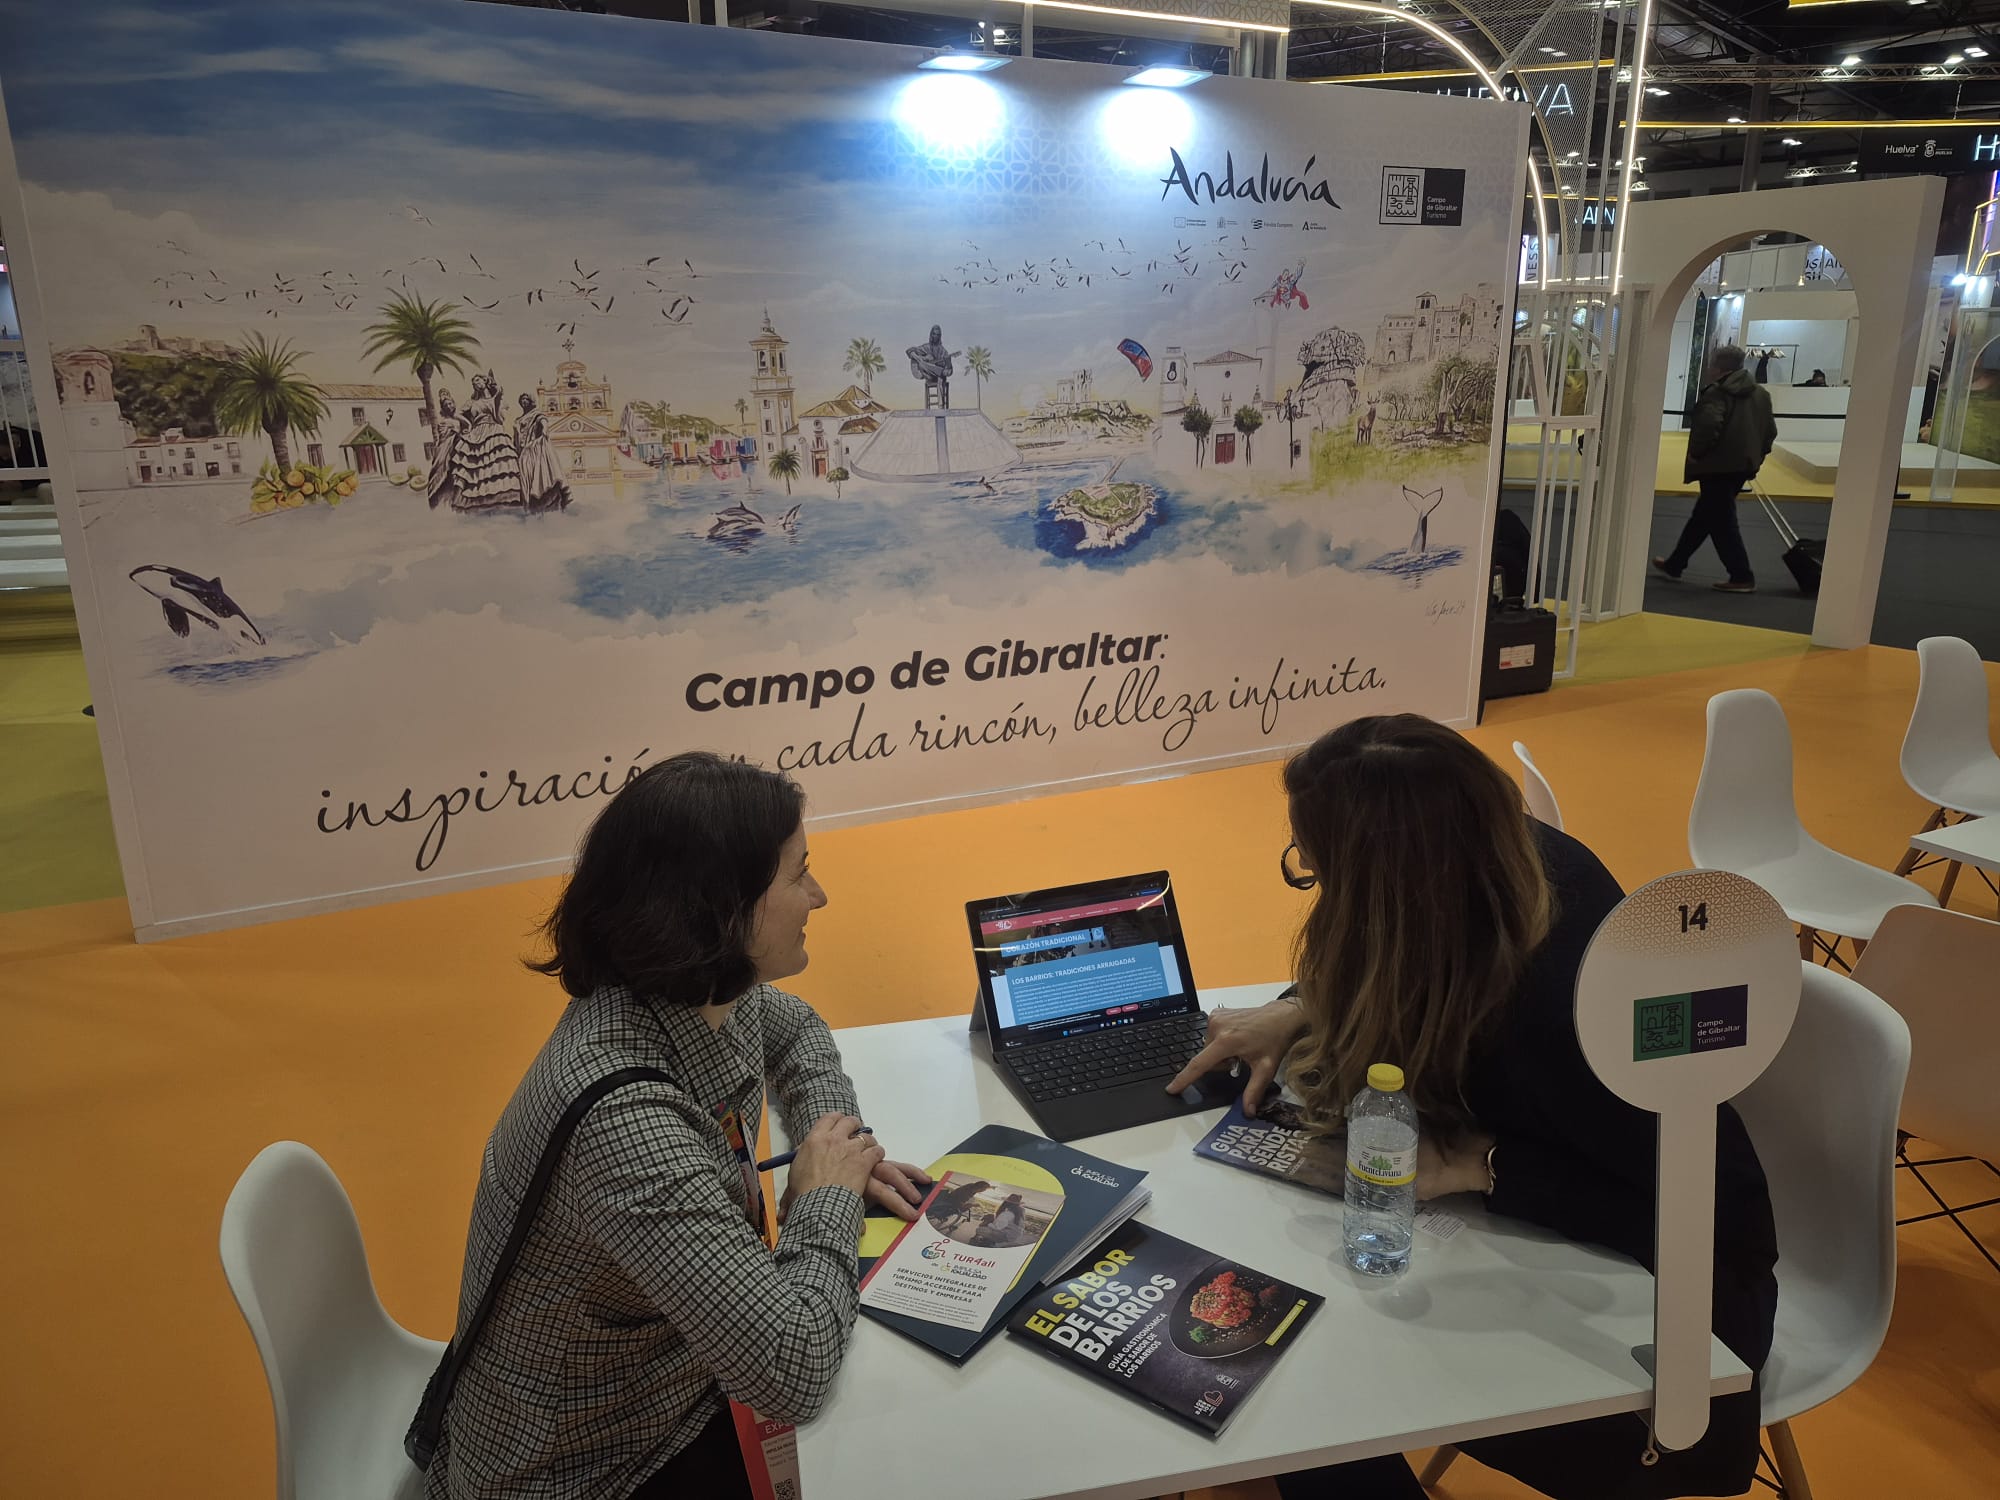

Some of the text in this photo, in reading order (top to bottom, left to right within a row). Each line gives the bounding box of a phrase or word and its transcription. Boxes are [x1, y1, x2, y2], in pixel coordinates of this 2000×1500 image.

[1885, 144, 1917, 155] Huelva
[1159, 146, 1342, 210] Andalucía
[1426, 196, 1446, 204] Campo
[684, 630, 1169, 713] Campo de Gibraltar:
[776, 702, 897, 772] cada
[908, 701, 1058, 753] rincón,
[1073, 665, 1221, 752] belleza
[1228, 656, 1387, 735] infinita.
[1678, 902, 1709, 934] 14
[1006, 934, 1086, 953] CORAZÓN TRADICIONAL
[1011, 977, 1025, 986] LOS
[1055, 964, 1096, 977] TRADICIONES
[1097, 957, 1137, 969] ARRAIGADAS
[1697, 1018, 1724, 1029] Campo
[1697, 1024, 1741, 1037] de Gibraltar
[1697, 1034, 1726, 1046] Turismo
[1210, 1125, 1249, 1153] GUÍA
[1228, 1128, 1270, 1160] PARA
[1247, 1126, 1292, 1166] SENDE
[953, 1253, 996, 1269] TUR4all
[892, 1273, 982, 1298] TURISMO ACCESIBLE PARA
[894, 1281, 928, 1294] DESTINOS
[935, 1291, 973, 1304] EMPRESAS
[897, 1267, 933, 1281] SERVICIOS
[934, 1276, 977, 1291] INTEGRALES
[1024, 1309, 1066, 1337] EL
[1052, 1249, 1136, 1309] SABOR
[1049, 1281, 1133, 1349] DE LOS
[1074, 1274, 1177, 1362] BARRIOS
[1107, 1313, 1168, 1370] GUÍA GASTRONÓMICA
[1115, 1332, 1158, 1374] Y DE SABOR DE
[1123, 1340, 1162, 1379] LOS BARRIOS
